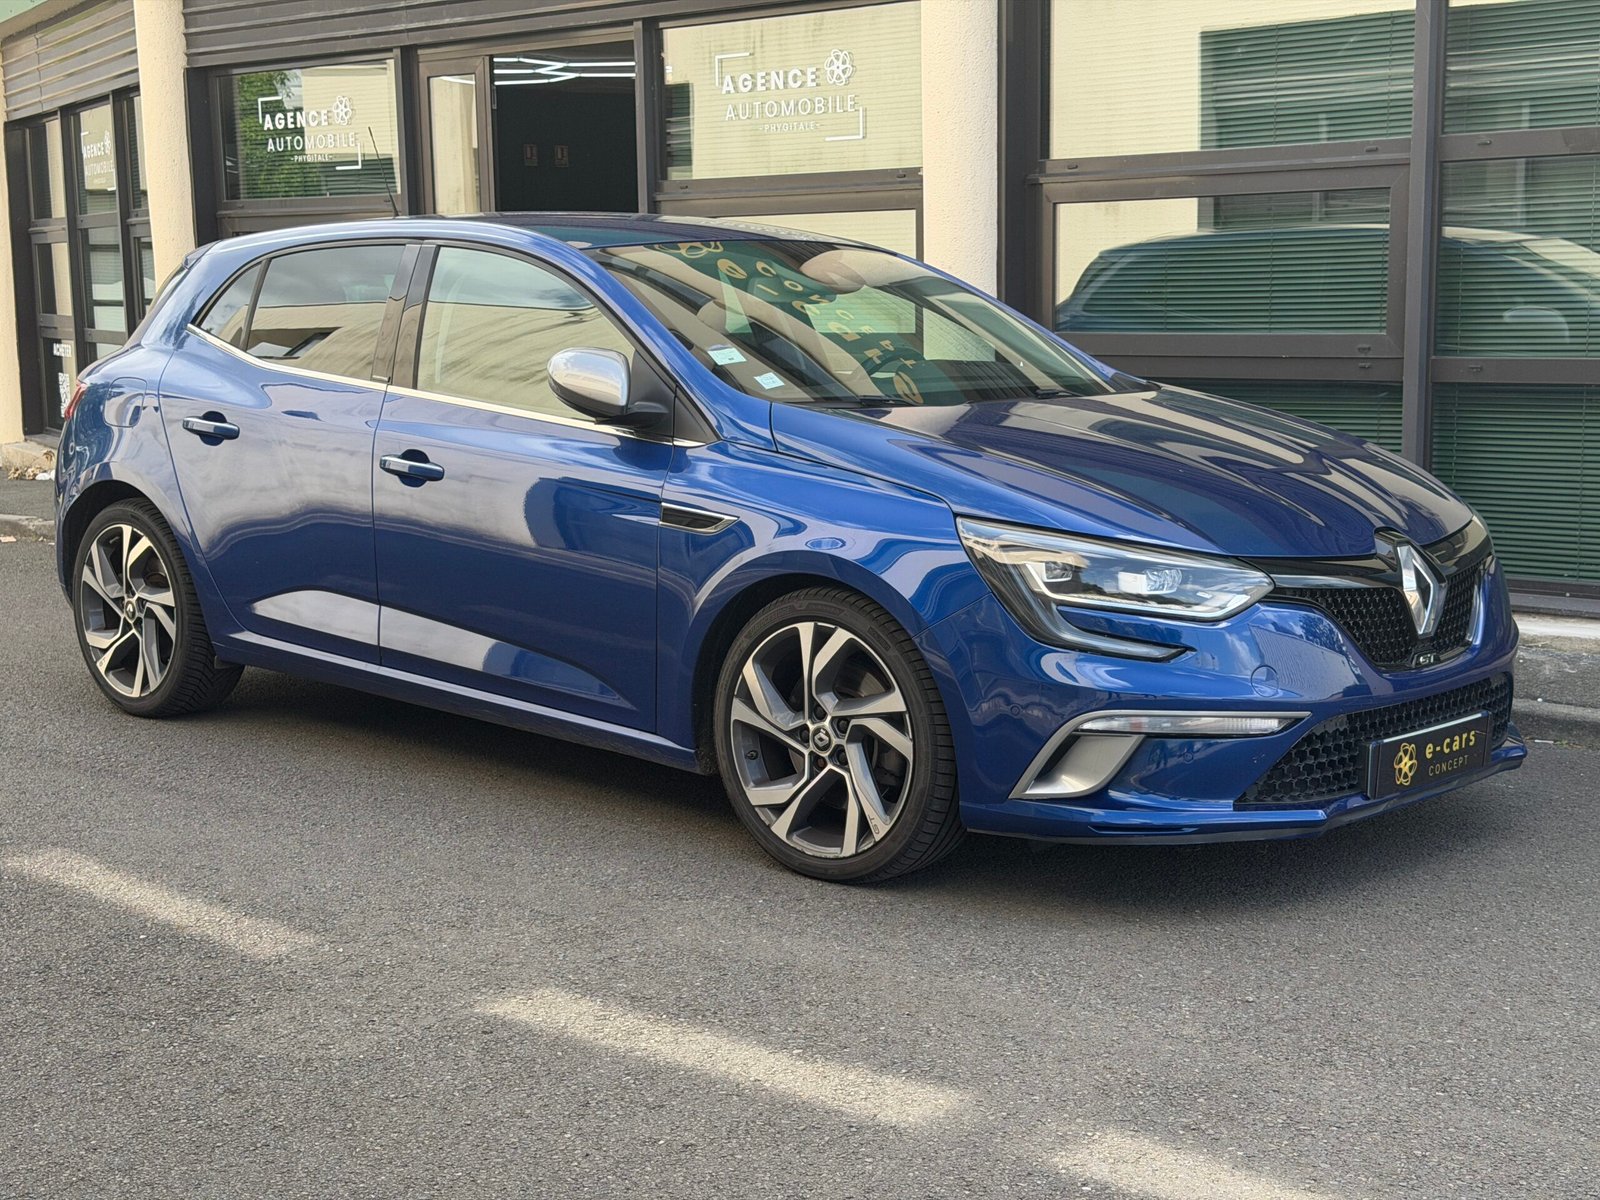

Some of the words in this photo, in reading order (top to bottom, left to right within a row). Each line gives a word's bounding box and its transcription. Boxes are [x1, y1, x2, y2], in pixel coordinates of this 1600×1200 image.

[722, 66, 818, 95] AGENCE
[725, 94, 857, 121] AUTOMOBILE
[263, 110, 329, 131] AGENCE
[266, 132, 356, 153] AUTOMOBILE
[1425, 730, 1476, 759] e-cars
[1428, 754, 1470, 777] CONCEPT
